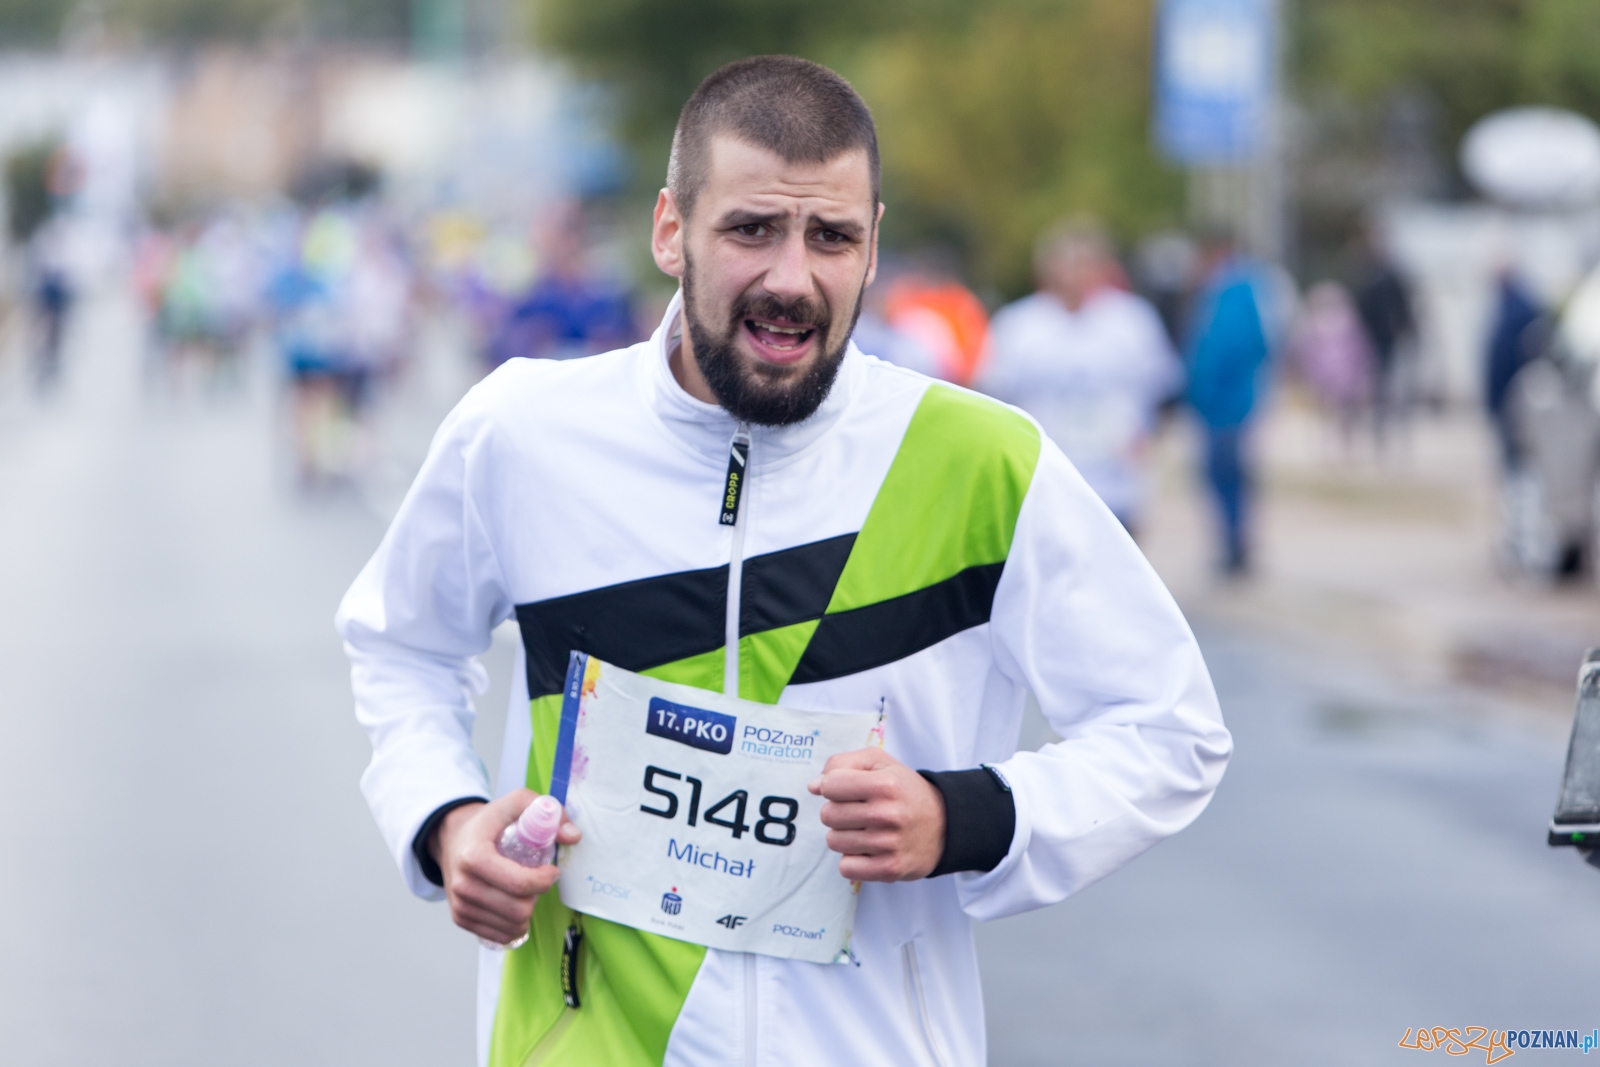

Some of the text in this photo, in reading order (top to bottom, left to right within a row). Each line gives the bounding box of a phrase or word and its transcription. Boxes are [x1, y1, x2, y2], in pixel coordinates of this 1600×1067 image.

[725, 472, 739, 509] CROPP
[656, 709, 727, 743] 17. PKO
[741, 740, 812, 759] maraton
[640, 765, 799, 847] 5148
[667, 838, 756, 879] Michał
[715, 914, 748, 930] 4F
